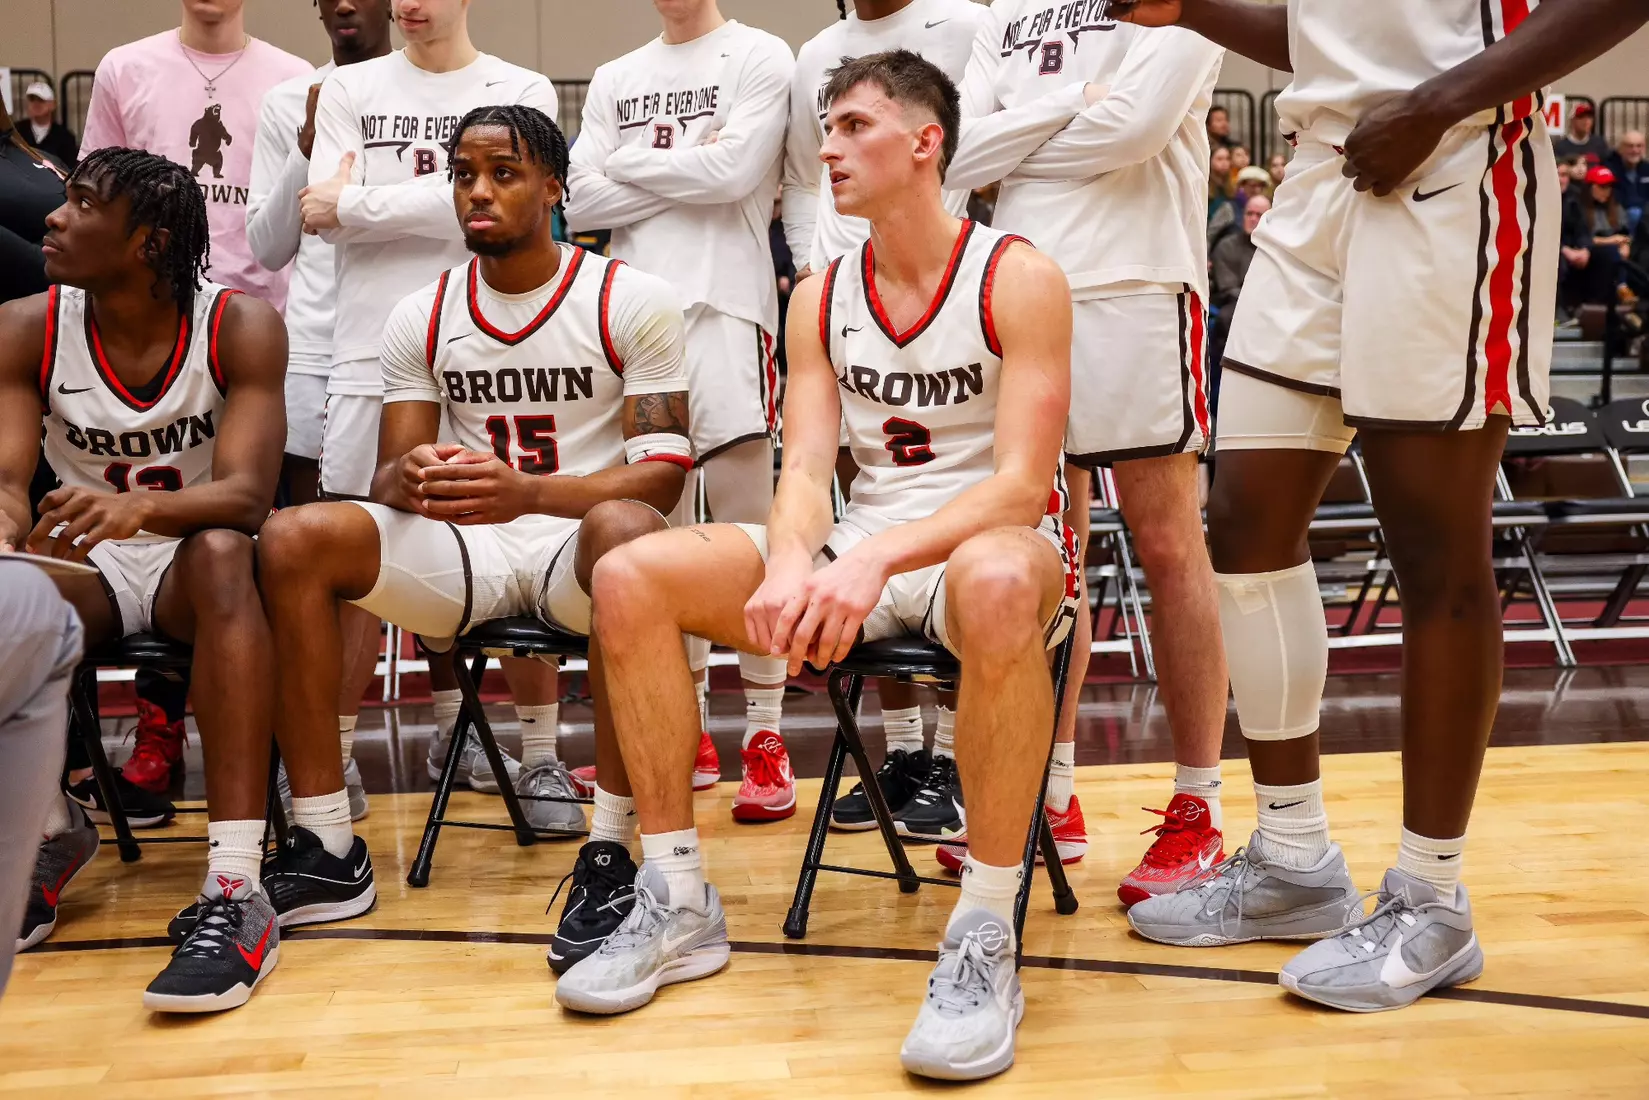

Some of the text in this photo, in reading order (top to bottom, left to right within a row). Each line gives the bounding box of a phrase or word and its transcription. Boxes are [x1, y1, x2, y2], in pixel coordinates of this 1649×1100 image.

[1039, 41, 1063, 76] B
[617, 98, 638, 122] NOT
[361, 115, 463, 140] NOT FOR EVER
[652, 123, 674, 149] B
[413, 148, 437, 177] B
[443, 366, 593, 403] BROWN
[485, 414, 560, 477] 15
[882, 416, 936, 467] 2
